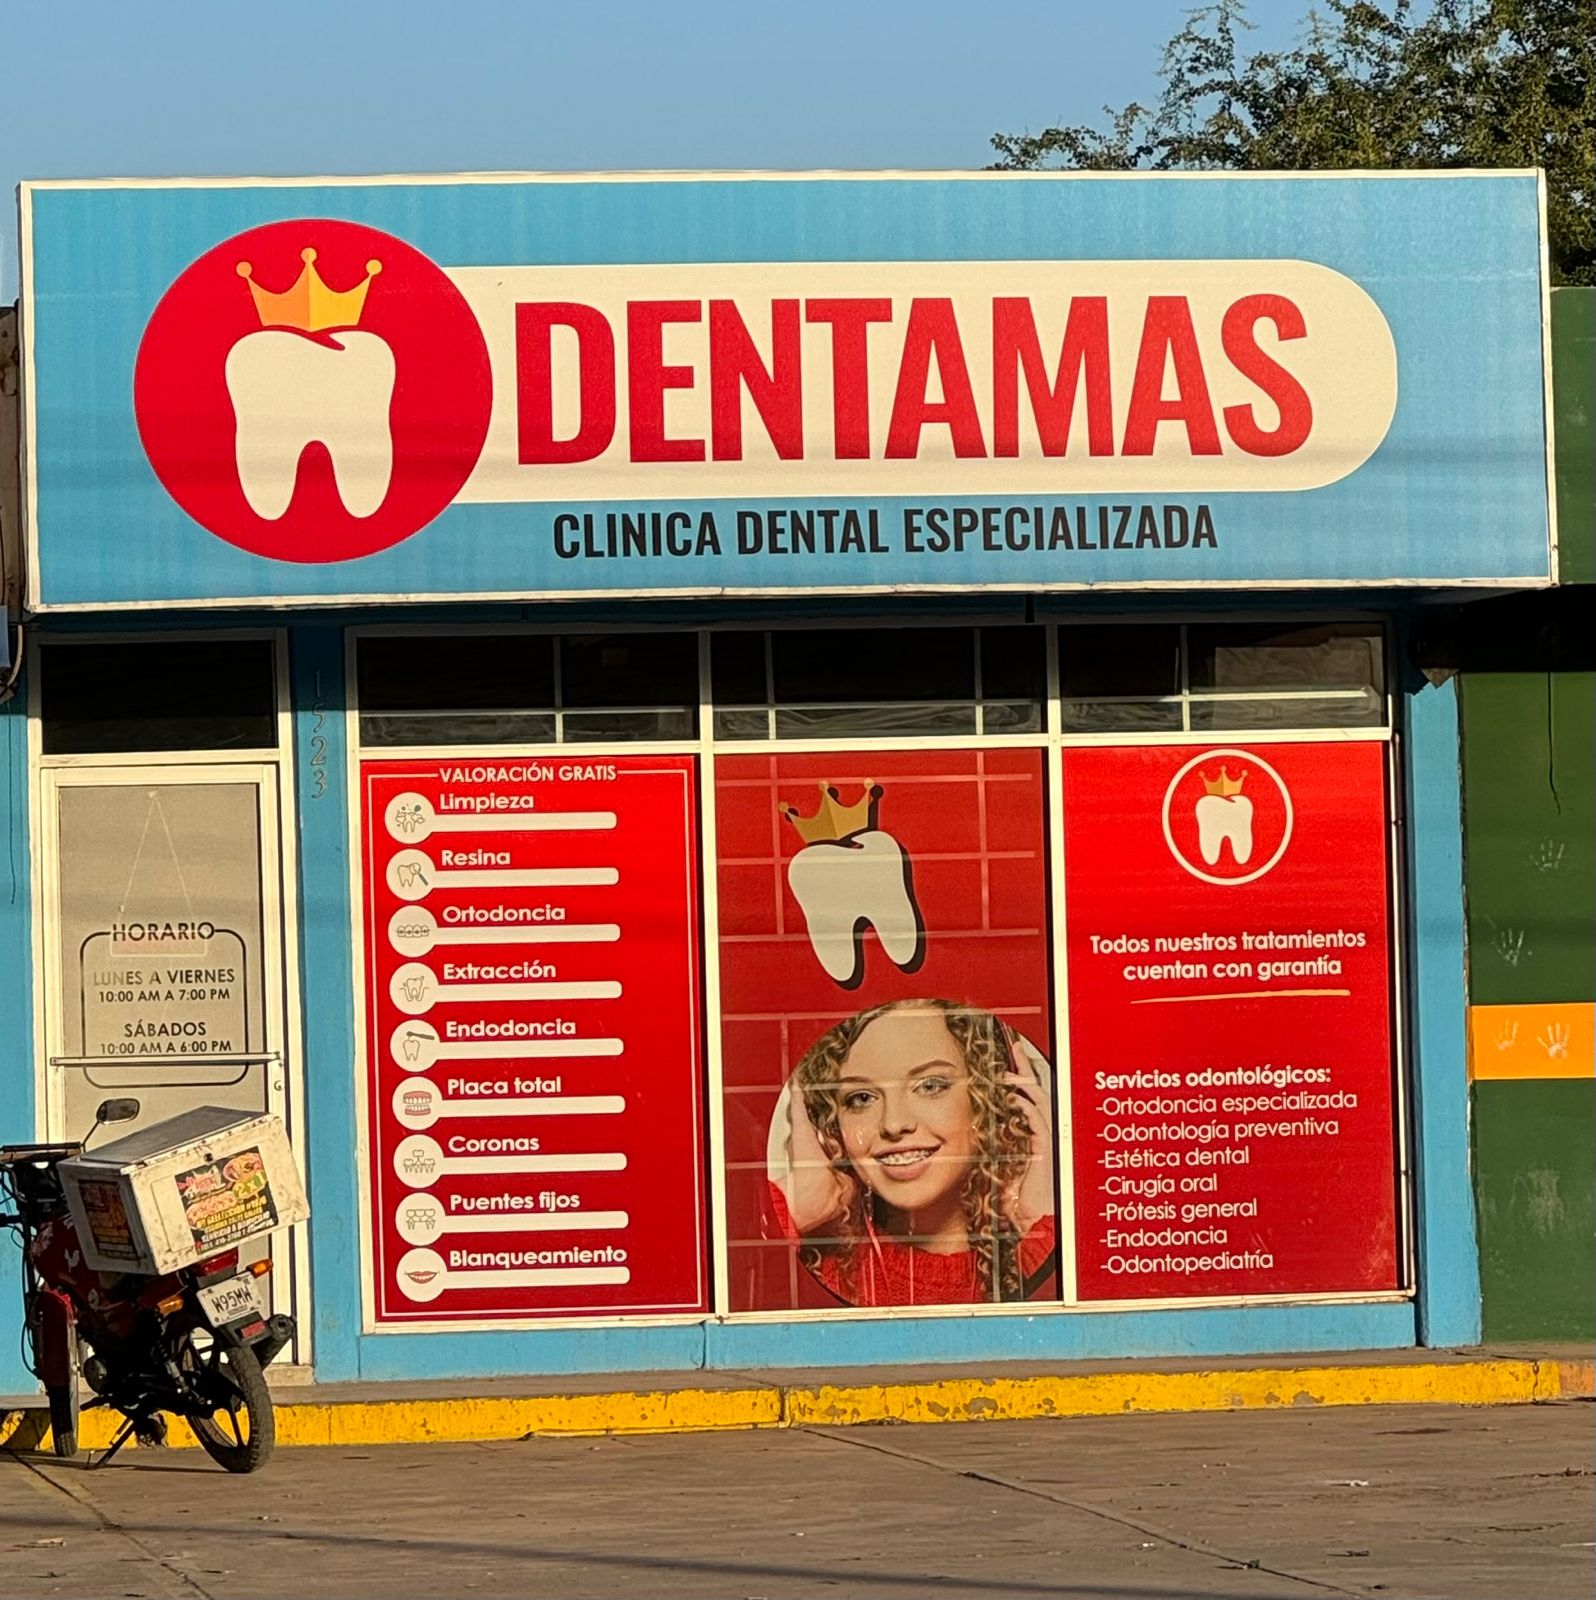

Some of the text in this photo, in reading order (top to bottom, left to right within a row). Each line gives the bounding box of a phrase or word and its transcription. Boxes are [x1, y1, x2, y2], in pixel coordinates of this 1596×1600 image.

[515, 292, 1314, 465] DENTAMAS
[553, 504, 1219, 559] CLINICA DENTAL ESPECIALIZADA
[310, 669, 327, 800] 1523
[439, 762, 617, 783] VALORACIÓN GRATIS
[440, 793, 534, 813] Limpieza
[441, 849, 511, 866] Resina
[442, 904, 566, 923] Ortodoncia
[112, 921, 215, 942] HORARIO
[1090, 929, 1366, 954] Todos nuestros tratamientos
[93, 968, 235, 986] LUNES A VIERNES
[443, 960, 556, 980] Extracción
[1123, 954, 1342, 981] cuentan con garantía
[99, 988, 230, 1003] 10:00 AM A 7:00 PM
[124, 1019, 207, 1038] SÁBADOS
[446, 1018, 576, 1038] Endodoncia
[101, 1040, 232, 1055] 10:00 AM A 6:00 PM
[447, 1077, 561, 1095] Placa total
[1095, 1064, 1331, 1089] Servicios odontológicos:
[1096, 1090, 1357, 1116] -Ortodoncia especializada
[1096, 1117, 1339, 1144] -Odontología preventiva
[448, 1136, 540, 1153] Coronas
[1097, 1146, 1250, 1169] -Estética dental
[1098, 1173, 1218, 1198] -Cirugía oral
[450, 1191, 580, 1212] Puentes fijos
[1098, 1198, 1258, 1223] -Prótesis general
[1099, 1226, 1228, 1248] -Endodoncia
[449, 1245, 628, 1269] Blanqueamiento
[1100, 1250, 1274, 1276] -Odontopediatría
